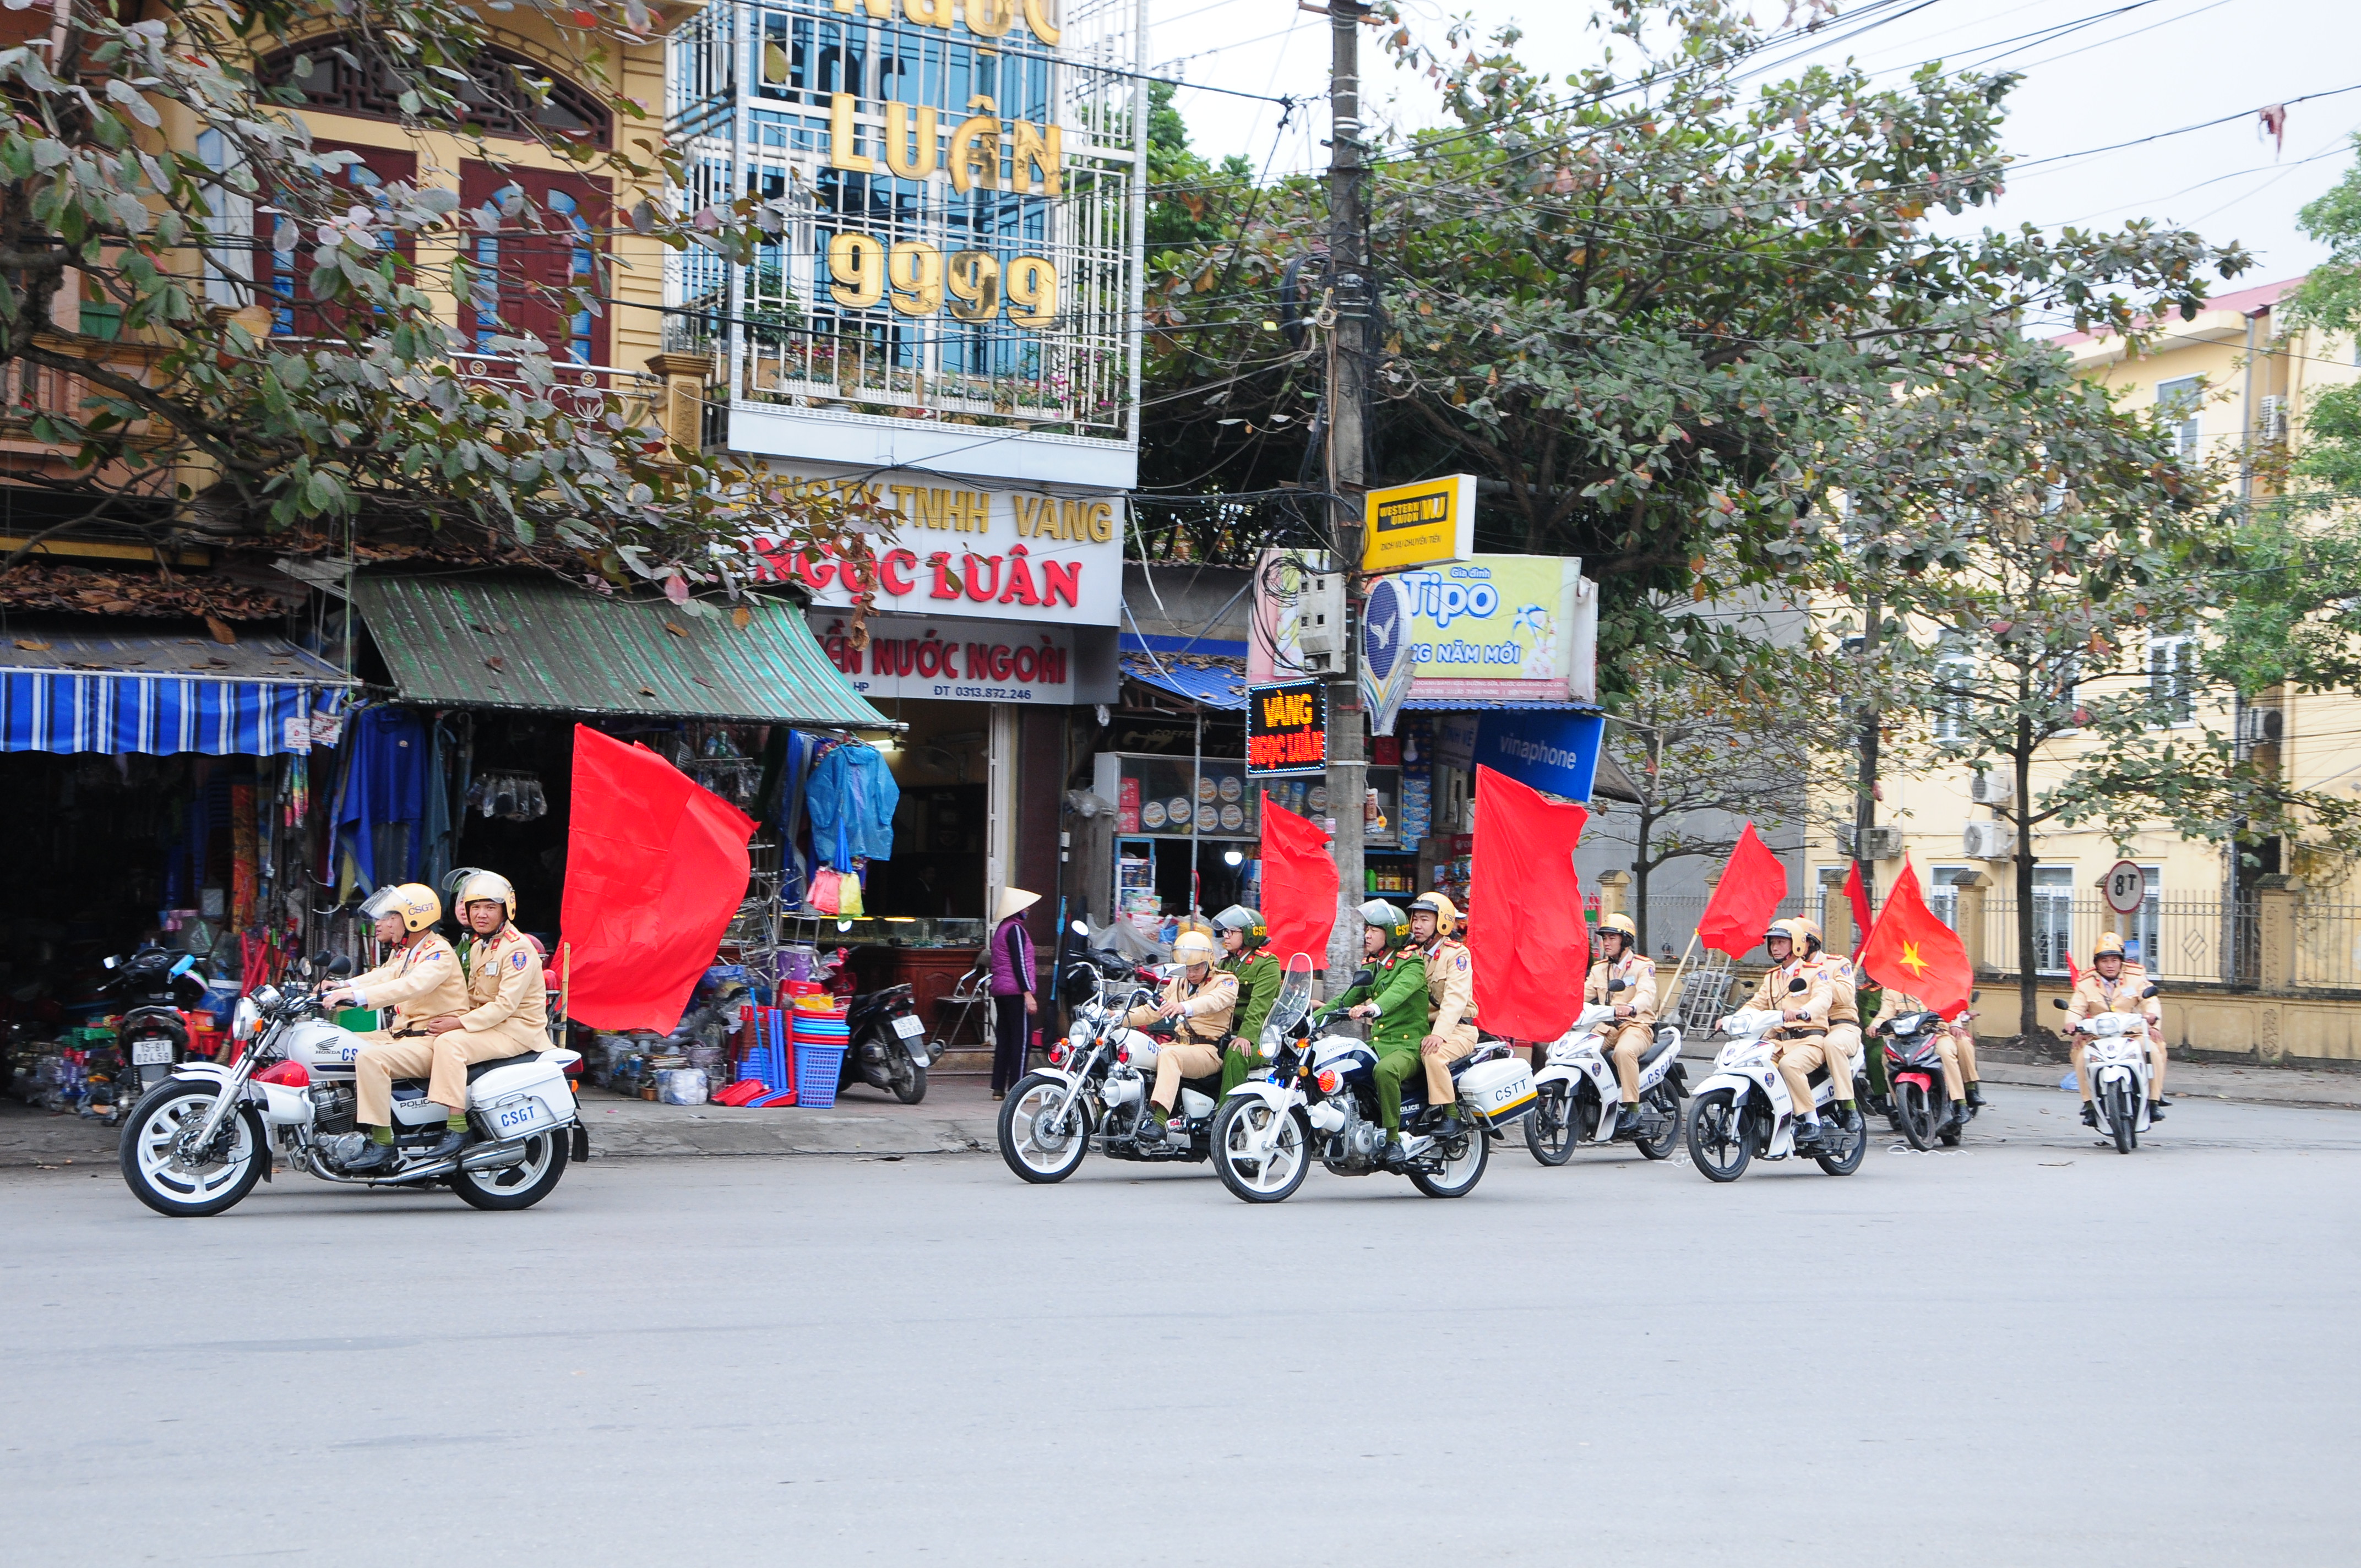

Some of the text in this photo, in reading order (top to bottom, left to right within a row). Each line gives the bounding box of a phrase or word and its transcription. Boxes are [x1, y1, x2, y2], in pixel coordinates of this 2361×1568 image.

[830, 92, 1062, 198] LUÂN
[828, 231, 1057, 329] 9999
[890, 484, 989, 533] TNHH
[1379, 502, 1419, 518] WESTERN
[1390, 512, 1419, 525] UNION
[929, 543, 1083, 608] LUÂN
[1450, 567, 1469, 578] Gia
[1400, 571, 1499, 629] Tipo
[873, 630, 959, 679] NƯỚC
[967, 635, 1067, 684] NGOÀI
[1437, 639, 1480, 664] NĂM
[1483, 640, 1521, 664] MỚI
[955, 687, 1032, 700] 0313.872.246
[1263, 689, 1313, 727] VÀNG
[1499, 732, 1577, 770] vinaphone
[408, 902, 434, 916] CSGT
[1495, 1078, 1526, 1102] CSTT
[501, 1106, 536, 1127] CSGT
